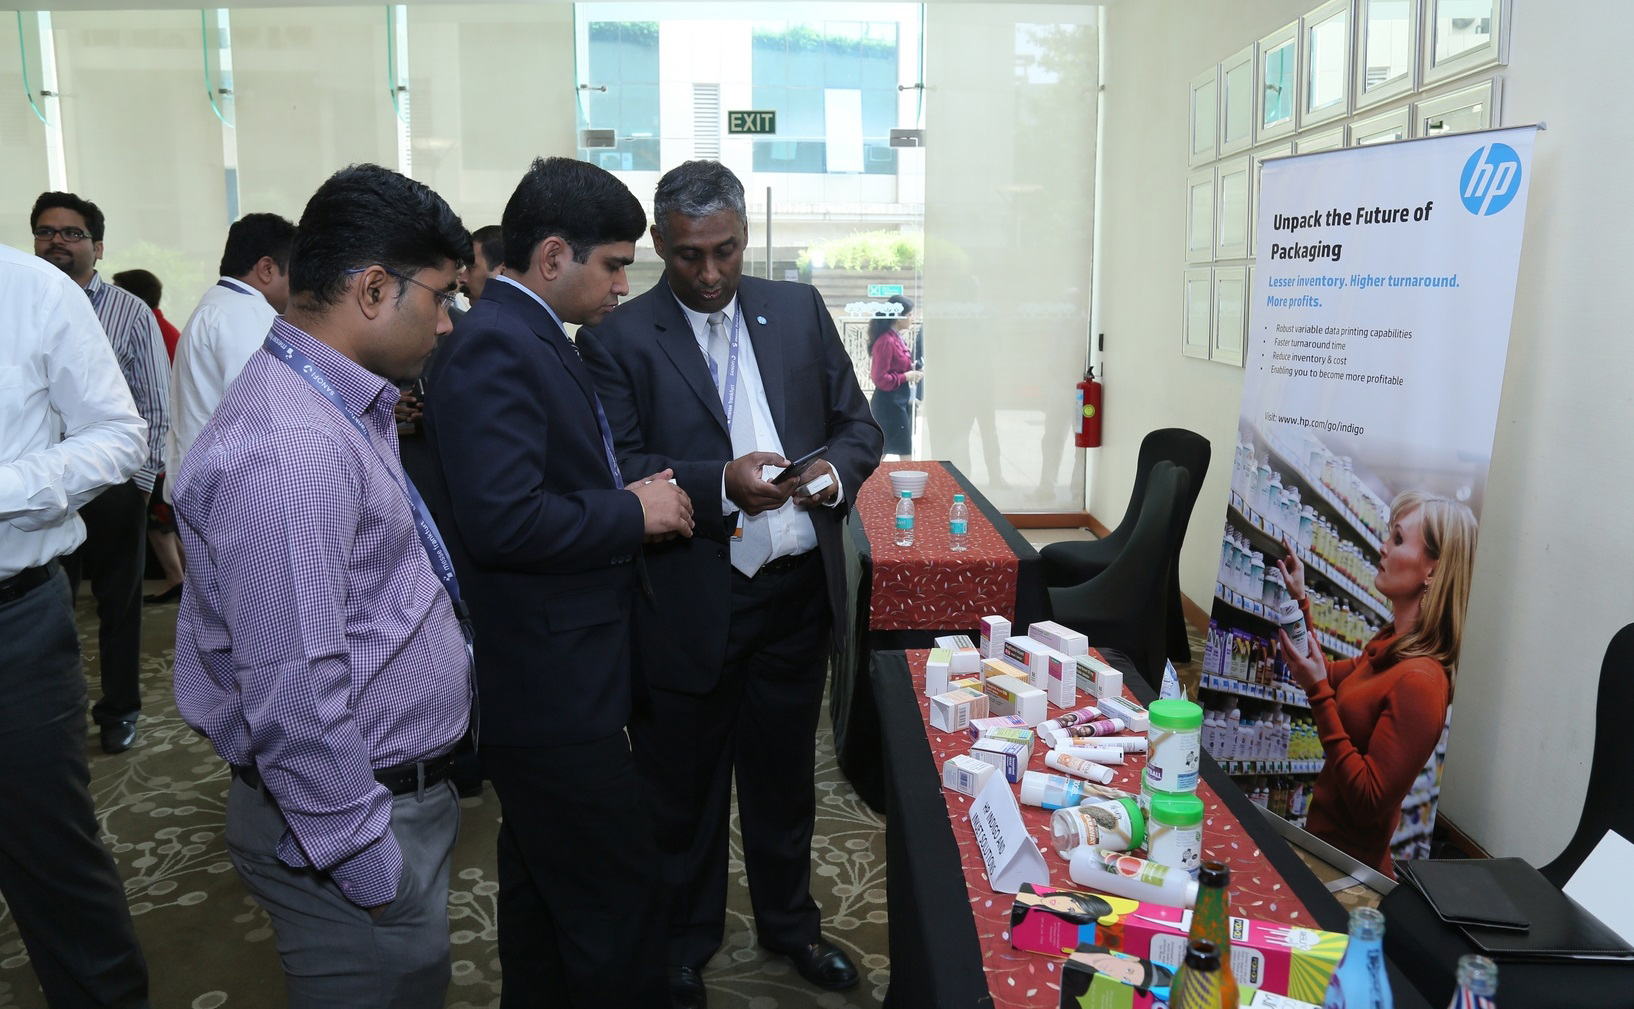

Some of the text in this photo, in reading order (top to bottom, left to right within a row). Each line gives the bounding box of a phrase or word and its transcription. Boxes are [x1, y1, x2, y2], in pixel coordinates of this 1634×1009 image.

[730, 113, 773, 131] EXIT
[1463, 143, 1518, 216] hp
[1273, 201, 1433, 233] Unpack the Future of
[1271, 240, 1342, 262] Packaging
[1268, 274, 1460, 290] Lesser inventory. Higher turnaround.
[1266, 295, 1322, 309] More profits.
[1276, 324, 1413, 339] Robust variable data printing capabilities
[1274, 338, 1346, 350] Faster turnaround time
[1272, 352, 1347, 365] Reduce inventory & cost
[310, 372, 335, 396] SANOFI
[1270, 365, 1404, 386] Enabling you to become more profitable
[1264, 411, 1365, 436] Visit: www.hp.com/go/indigo
[420, 520, 450, 571] messe frankfurt
[982, 801, 1006, 855] HP INDIGO AND
[972, 812, 996, 876] INKJET SOLUTIONS
